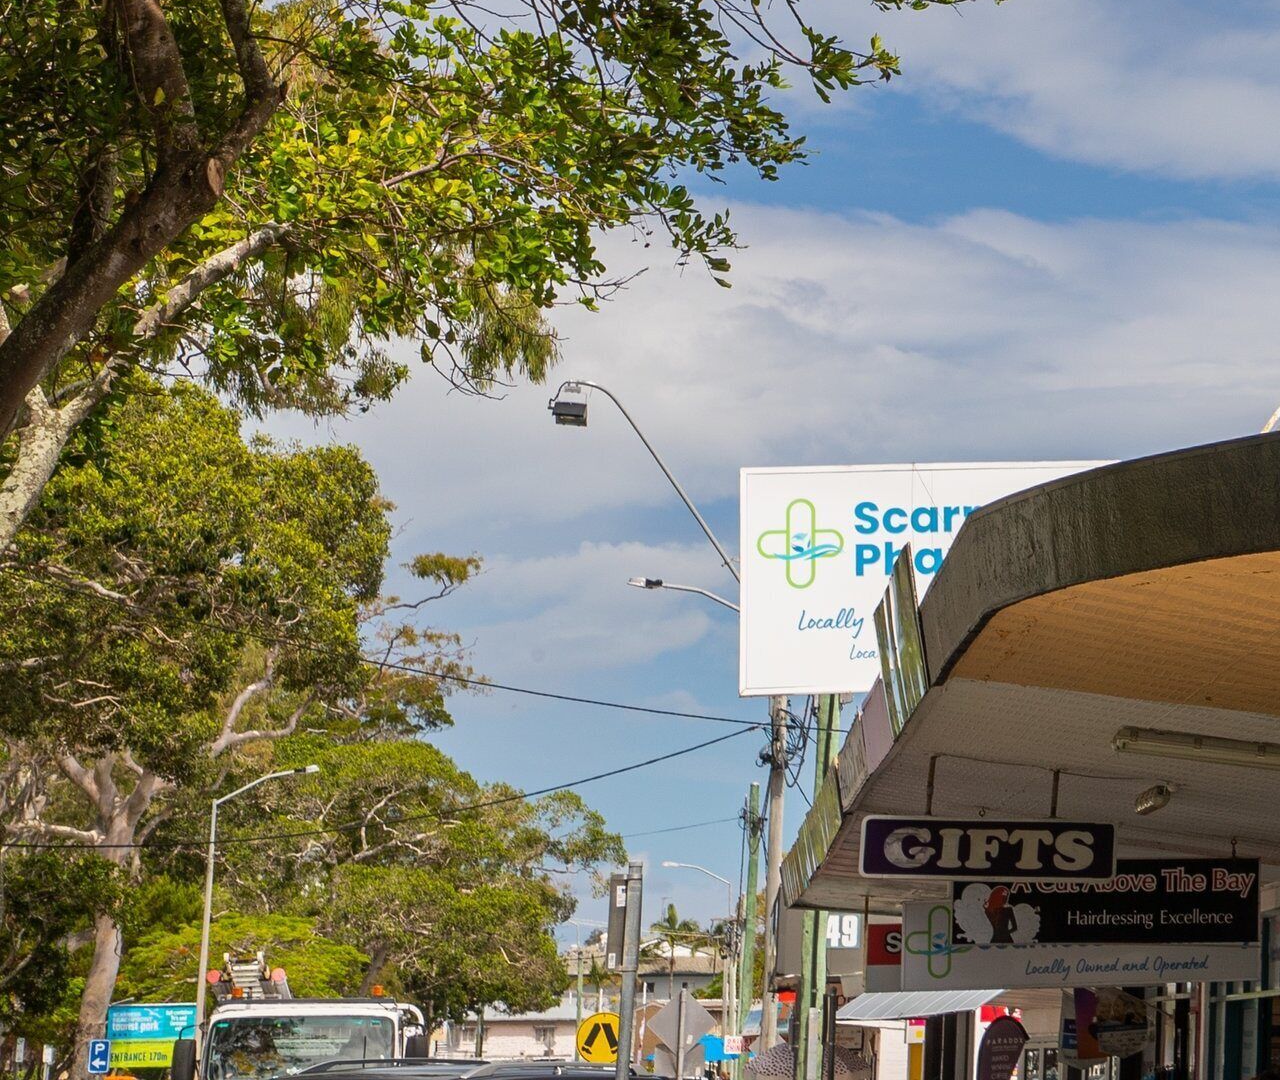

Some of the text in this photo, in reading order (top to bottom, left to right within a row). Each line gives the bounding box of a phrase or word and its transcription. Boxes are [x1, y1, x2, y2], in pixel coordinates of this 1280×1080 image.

[855, 541, 950, 576] Pha
[798, 607, 864, 639] Locally
[883, 826, 1094, 871] GIFTS
[1161, 867, 1207, 892] The
[1211, 868, 1256, 898] Bay
[1067, 910, 1234, 930] Hairdressing Excellence
[1025, 955, 1209, 981] Locally Owned and Operated
[112, 1022, 139, 1032] tourist
[140, 1021, 159, 1034] park
[95, 1044, 105, 1055] P
[111, 1053, 146, 1063] ENTRANCE
